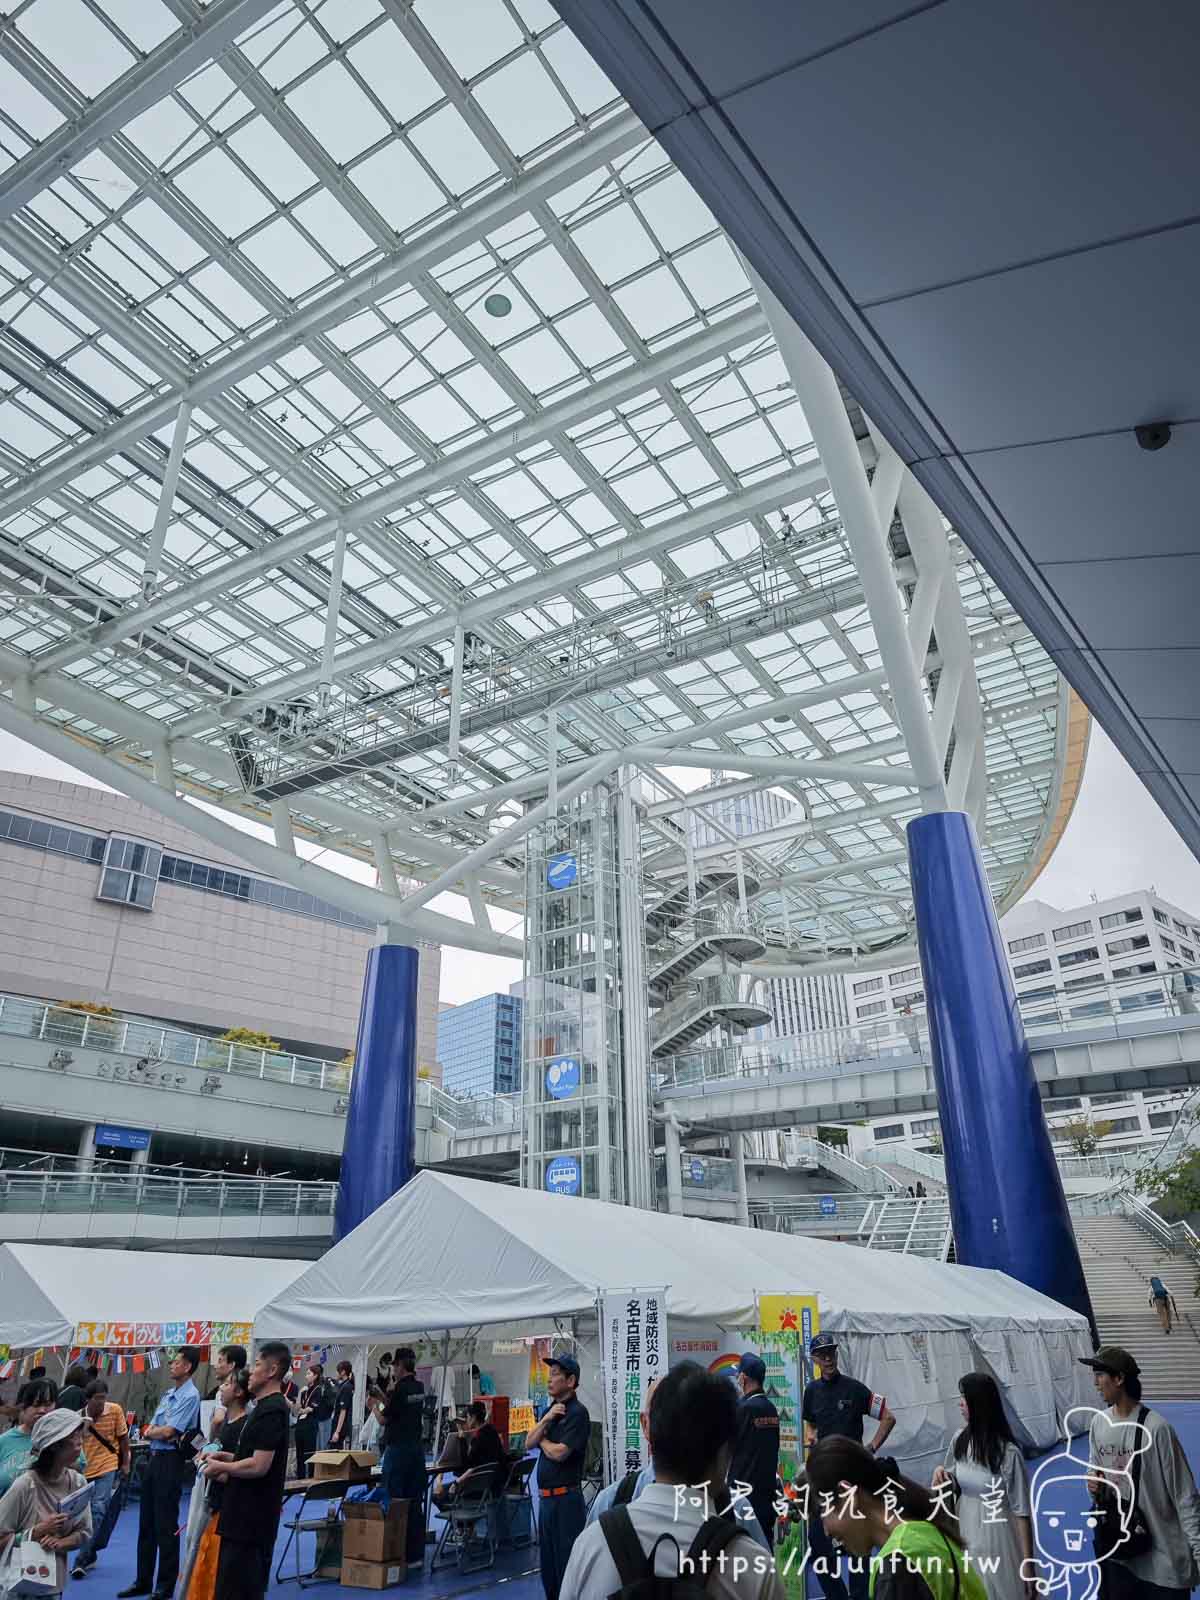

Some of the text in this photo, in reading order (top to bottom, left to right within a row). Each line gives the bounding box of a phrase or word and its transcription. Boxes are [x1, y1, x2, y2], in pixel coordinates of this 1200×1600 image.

[625, 1299, 641, 1476] 名古屋市消防団員募
